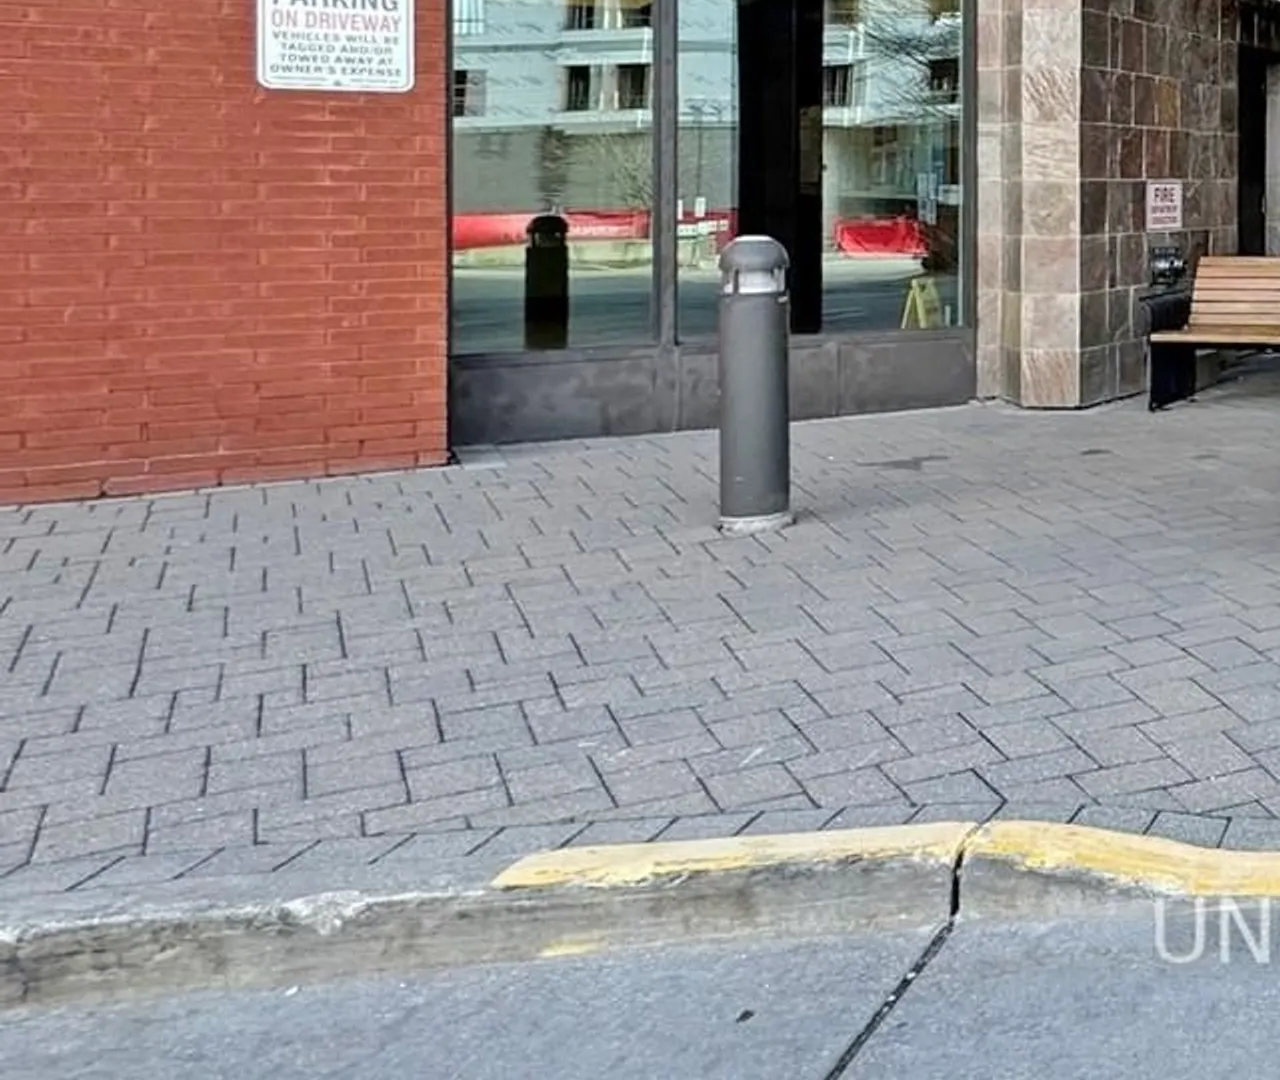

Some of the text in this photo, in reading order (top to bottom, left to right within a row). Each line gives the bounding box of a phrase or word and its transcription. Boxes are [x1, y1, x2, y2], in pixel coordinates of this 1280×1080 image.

[271, 8, 401, 33] ON DRIVEWAY
[272, 30, 341, 43] VEHICLES
[345, 33, 378, 44] WILL
[341, 67, 401, 78] EXPENSE
[1154, 186, 1176, 203] FIRE
